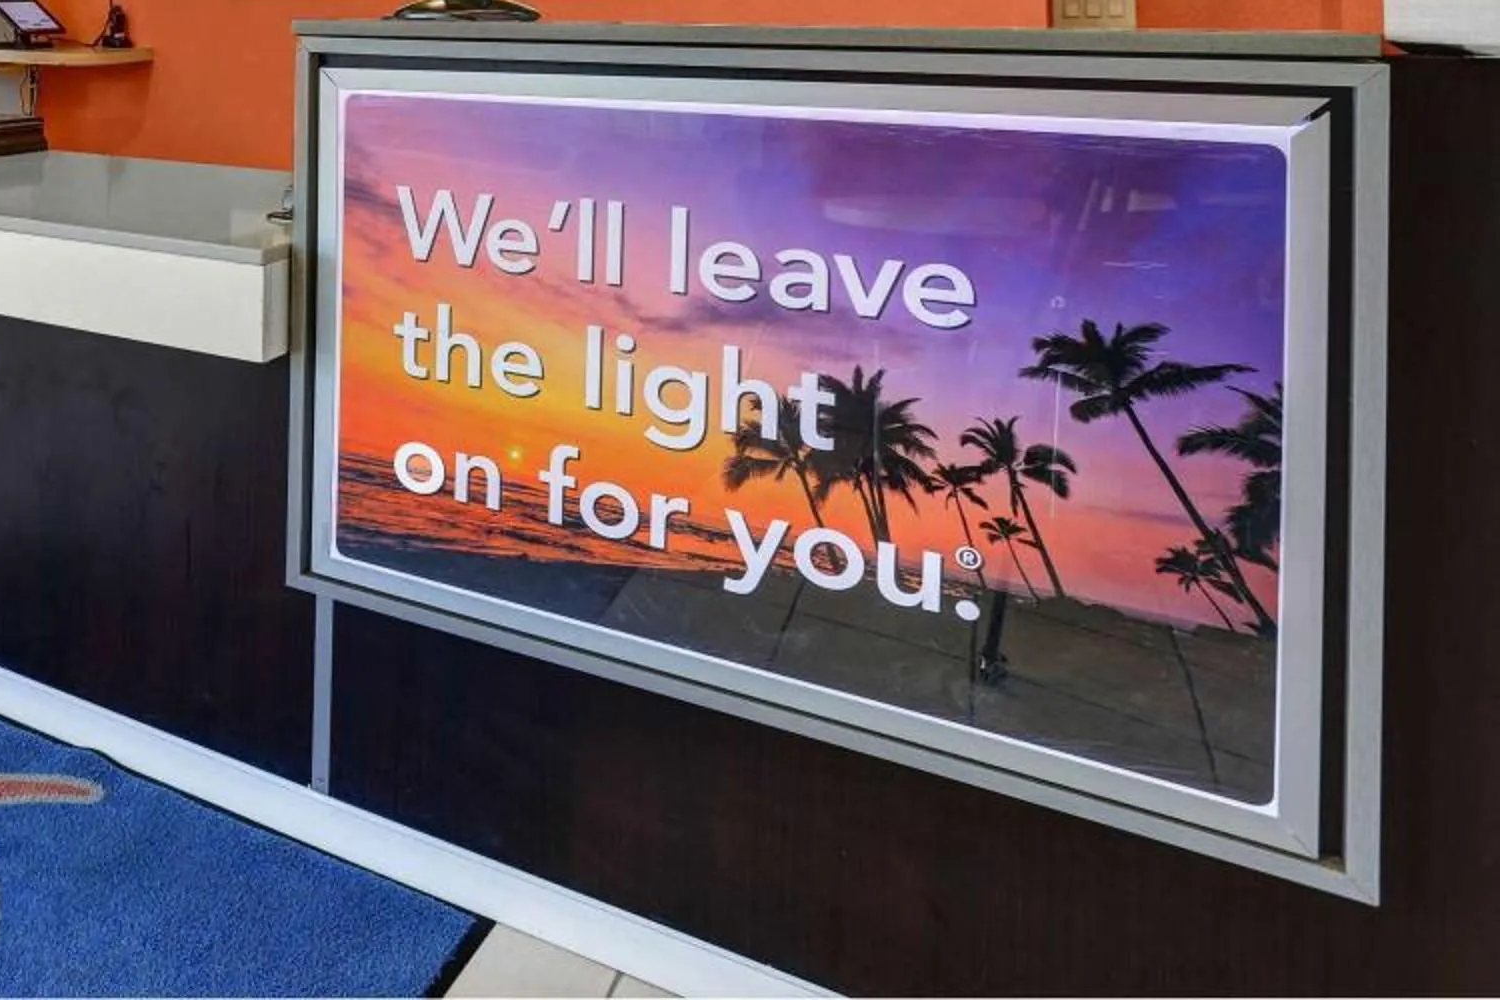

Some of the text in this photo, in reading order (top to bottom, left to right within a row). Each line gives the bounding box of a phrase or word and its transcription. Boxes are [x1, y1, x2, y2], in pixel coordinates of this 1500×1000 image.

[396, 184, 977, 330] We'll leave
[392, 302, 836, 451] the light
[392, 440, 502, 511] on
[538, 443, 689, 550] for
